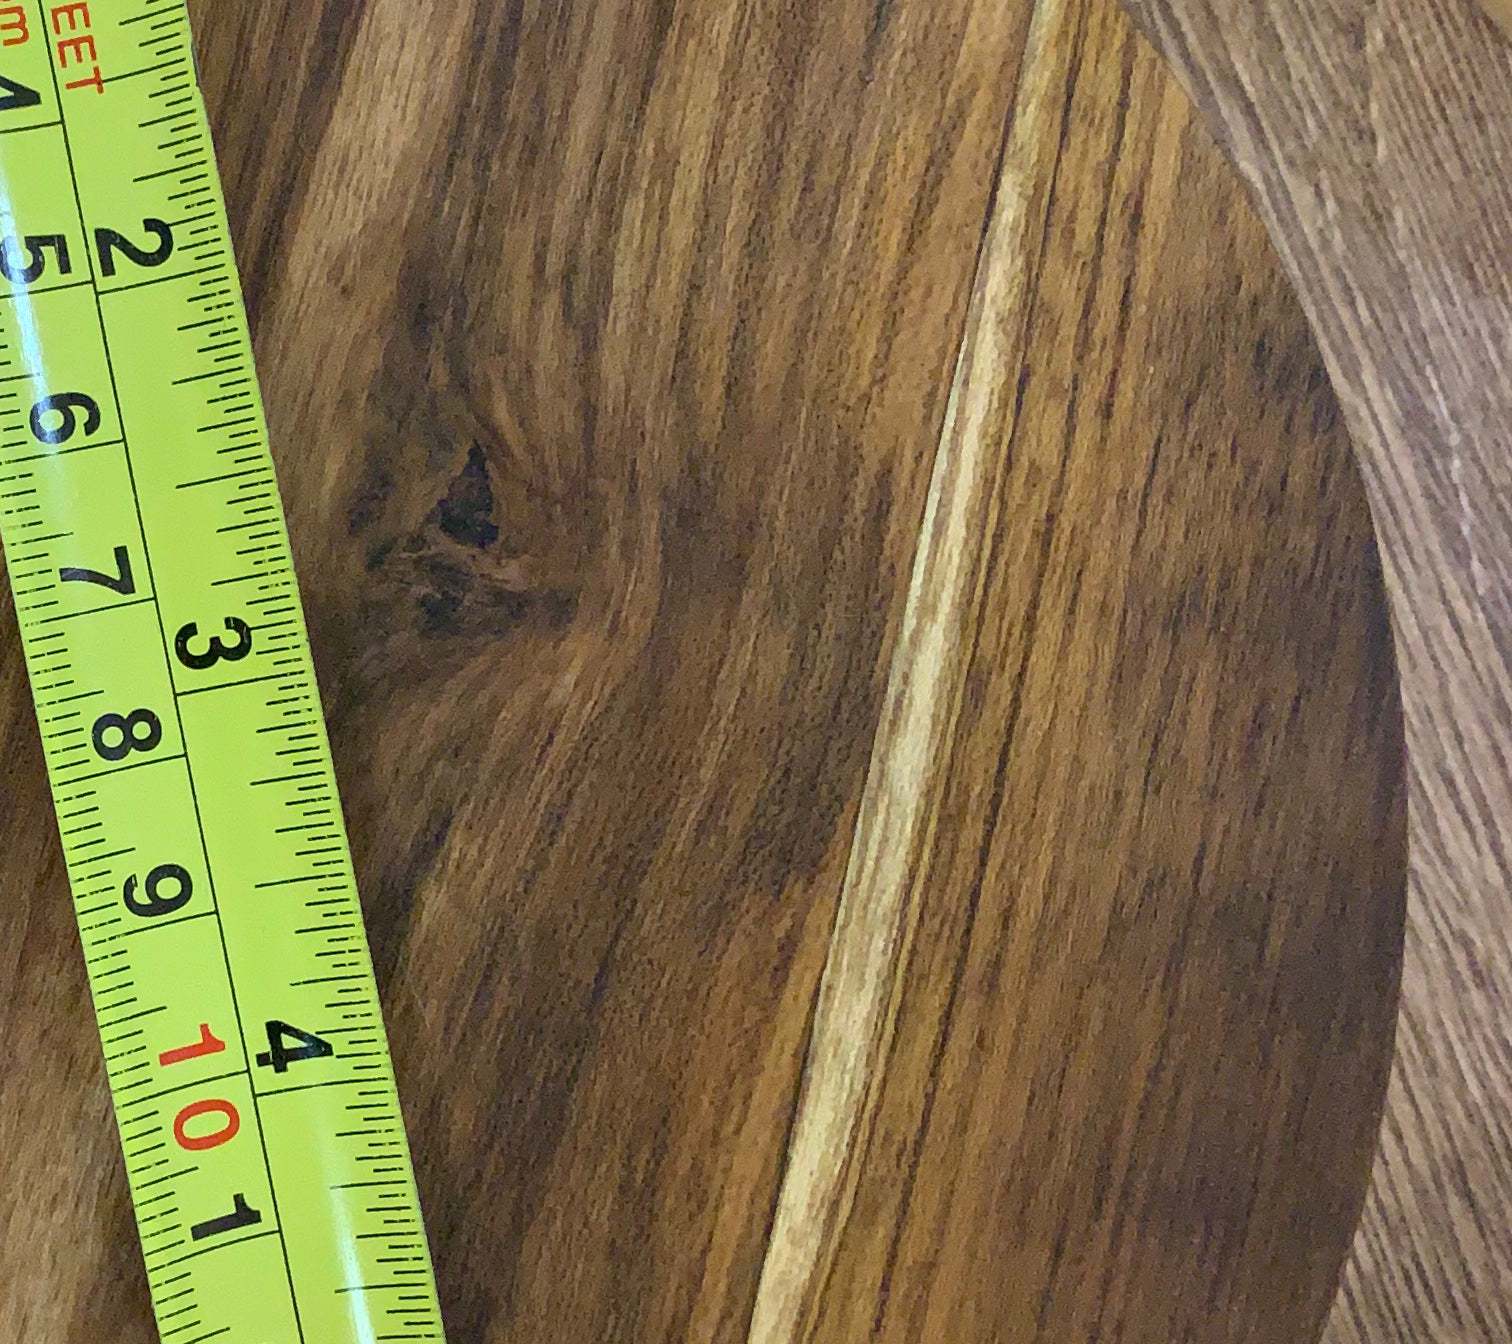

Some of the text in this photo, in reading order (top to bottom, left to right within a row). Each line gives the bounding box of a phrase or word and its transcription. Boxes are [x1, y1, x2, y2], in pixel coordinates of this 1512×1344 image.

[29, 392, 101, 444] 6
[59, 546, 135, 595] 7
[94, 218, 175, 277] 2
[174, 616, 252, 670] 3
[255, 1020, 334, 1074] 4
[91, 708, 162, 762] 8
[123, 863, 193, 918] 9
[191, 1193, 262, 1242] 1
